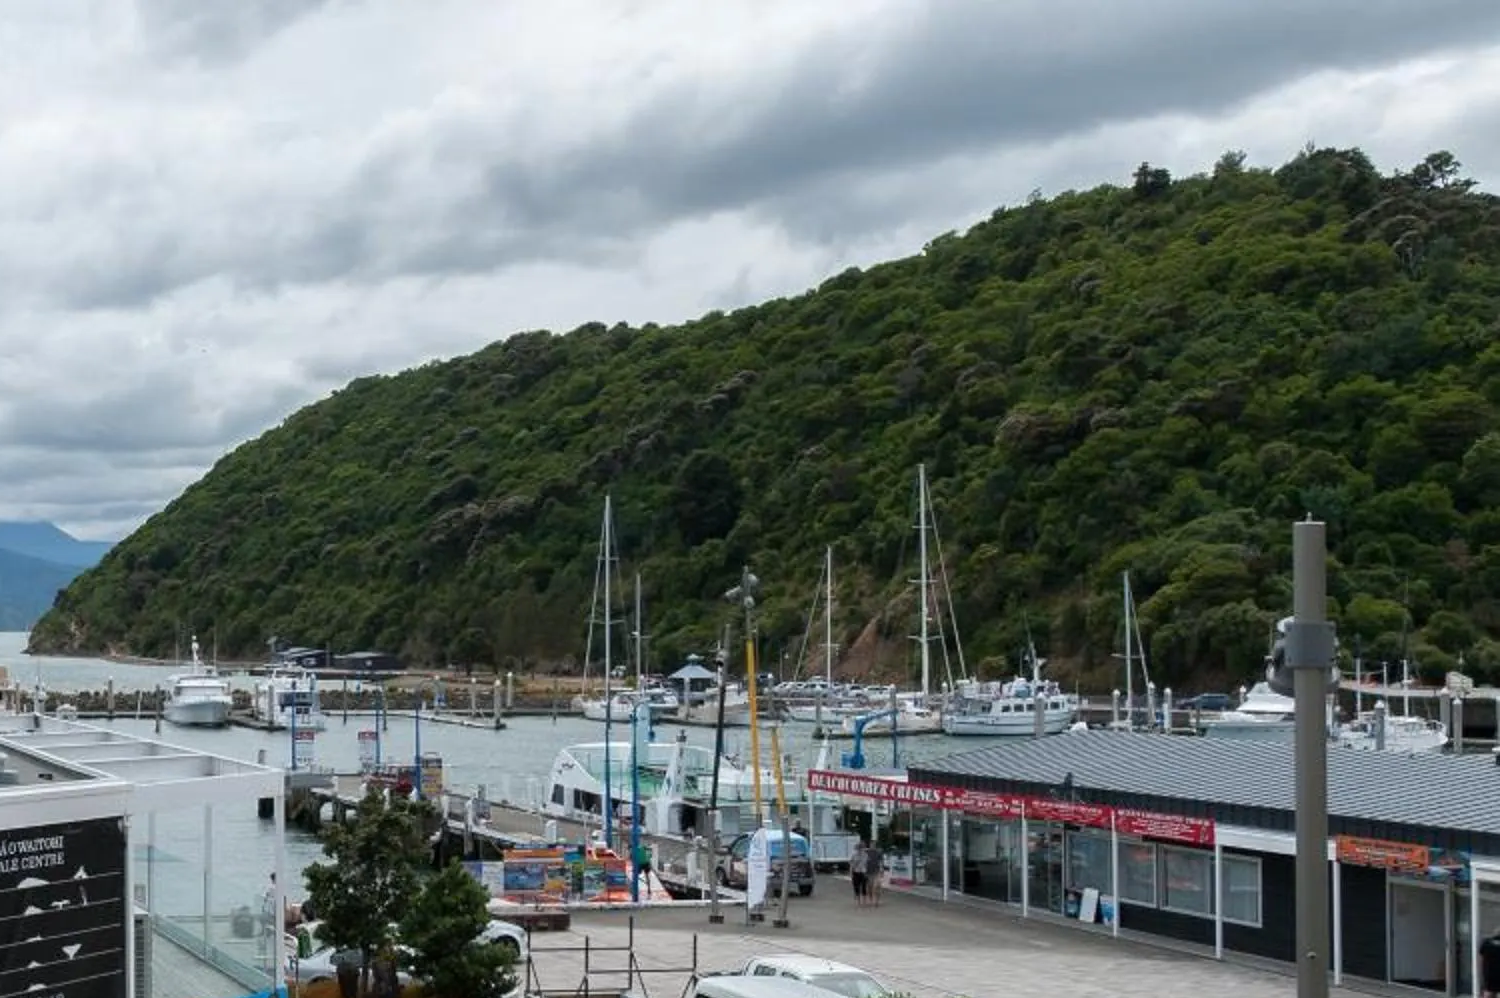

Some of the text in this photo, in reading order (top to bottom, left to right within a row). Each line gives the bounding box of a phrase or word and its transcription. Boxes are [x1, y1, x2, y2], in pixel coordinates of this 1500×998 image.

[811, 773, 888, 797] BEACHCOMBER
[890, 782, 940, 803] CRUISES
[21, 852, 65, 870] CENTRE
